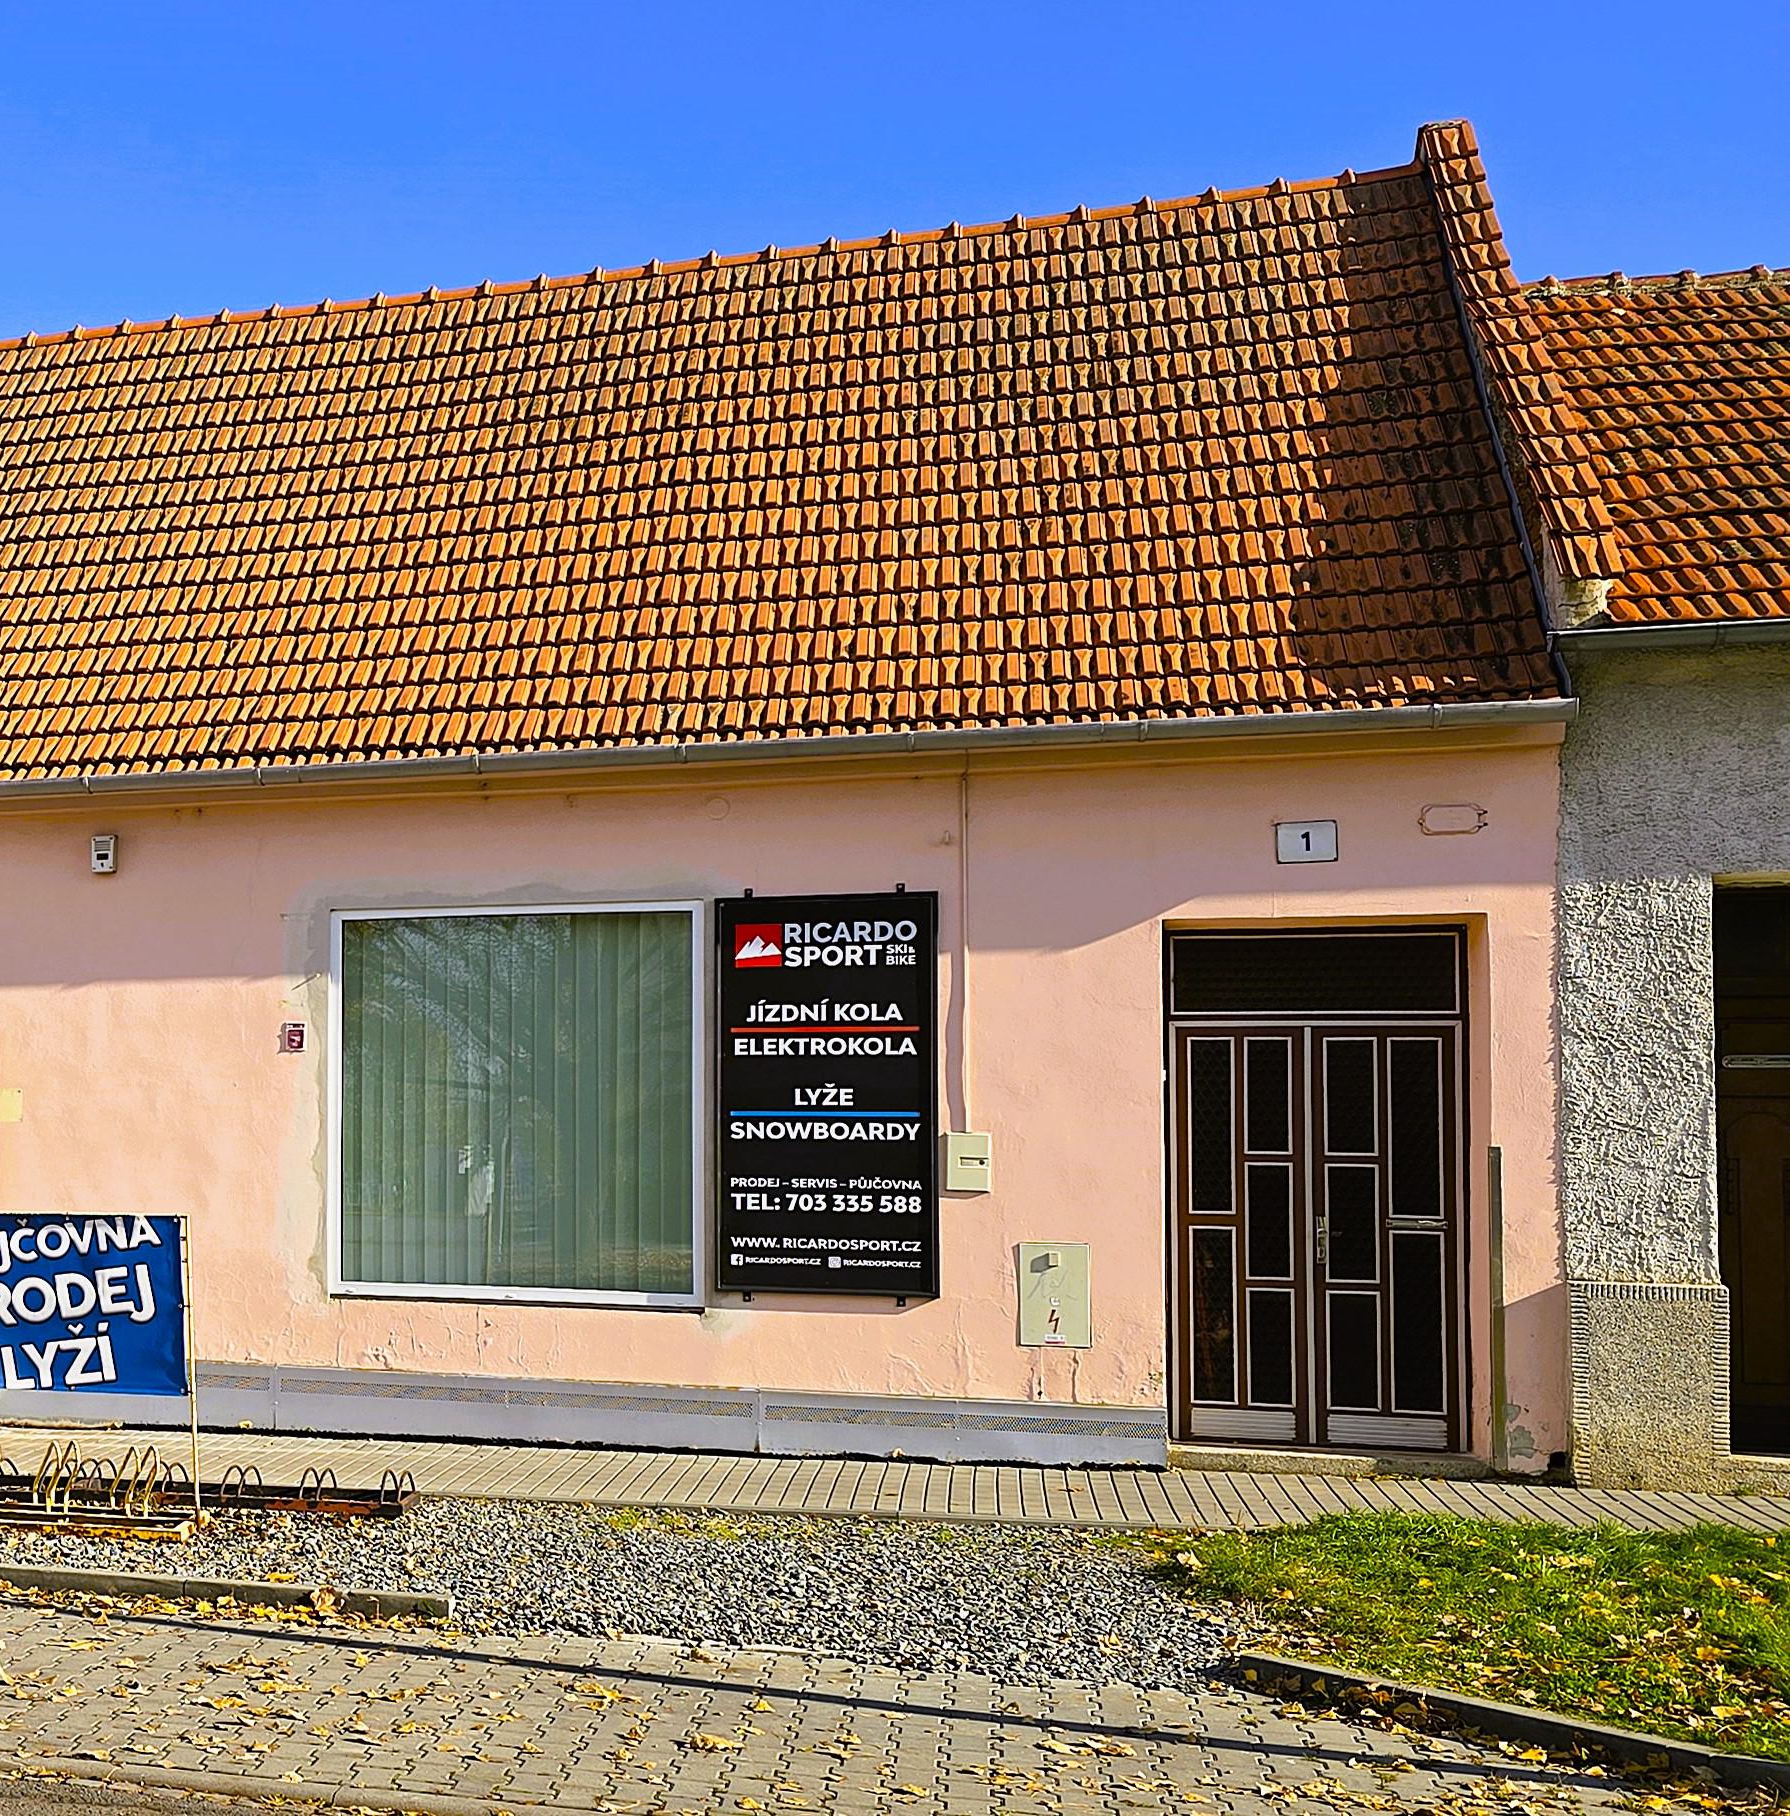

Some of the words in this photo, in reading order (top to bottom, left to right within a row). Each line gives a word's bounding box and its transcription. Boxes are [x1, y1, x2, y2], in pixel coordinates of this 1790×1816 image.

[1300, 831, 1311, 852] 1
[784, 920, 918, 944] RICARDO
[784, 945, 883, 967] SPORT
[885, 955, 916, 965] BIKE
[746, 998, 829, 1022] JÍZDNÍ
[834, 1003, 903, 1021] KOLA
[734, 1037, 918, 1056] ELEKTROKOLA
[794, 1083, 854, 1106] LYŽE
[730, 1122, 921, 1141] SNOWBOARDY
[730, 1177, 780, 1188] PRODEJ
[791, 1178, 837, 1189] SERVIS
[849, 1176, 922, 1190] PŮJČOVNA
[730, 1193, 781, 1211] TEL:
[785, 1194, 827, 1211] 703
[832, 1195, 874, 1212] 335
[879, 1196, 922, 1213] 588
[730, 1237, 781, 1248] WWW.
[783, 1238, 922, 1252] RICARDOSPORT.CZ
[745, 1256, 822, 1265] RICARDOSPORT.CZ
[843, 1259, 922, 1268] RICARDOSPORT.CZ
[0, 1322, 117, 1389] LYŽÍ
